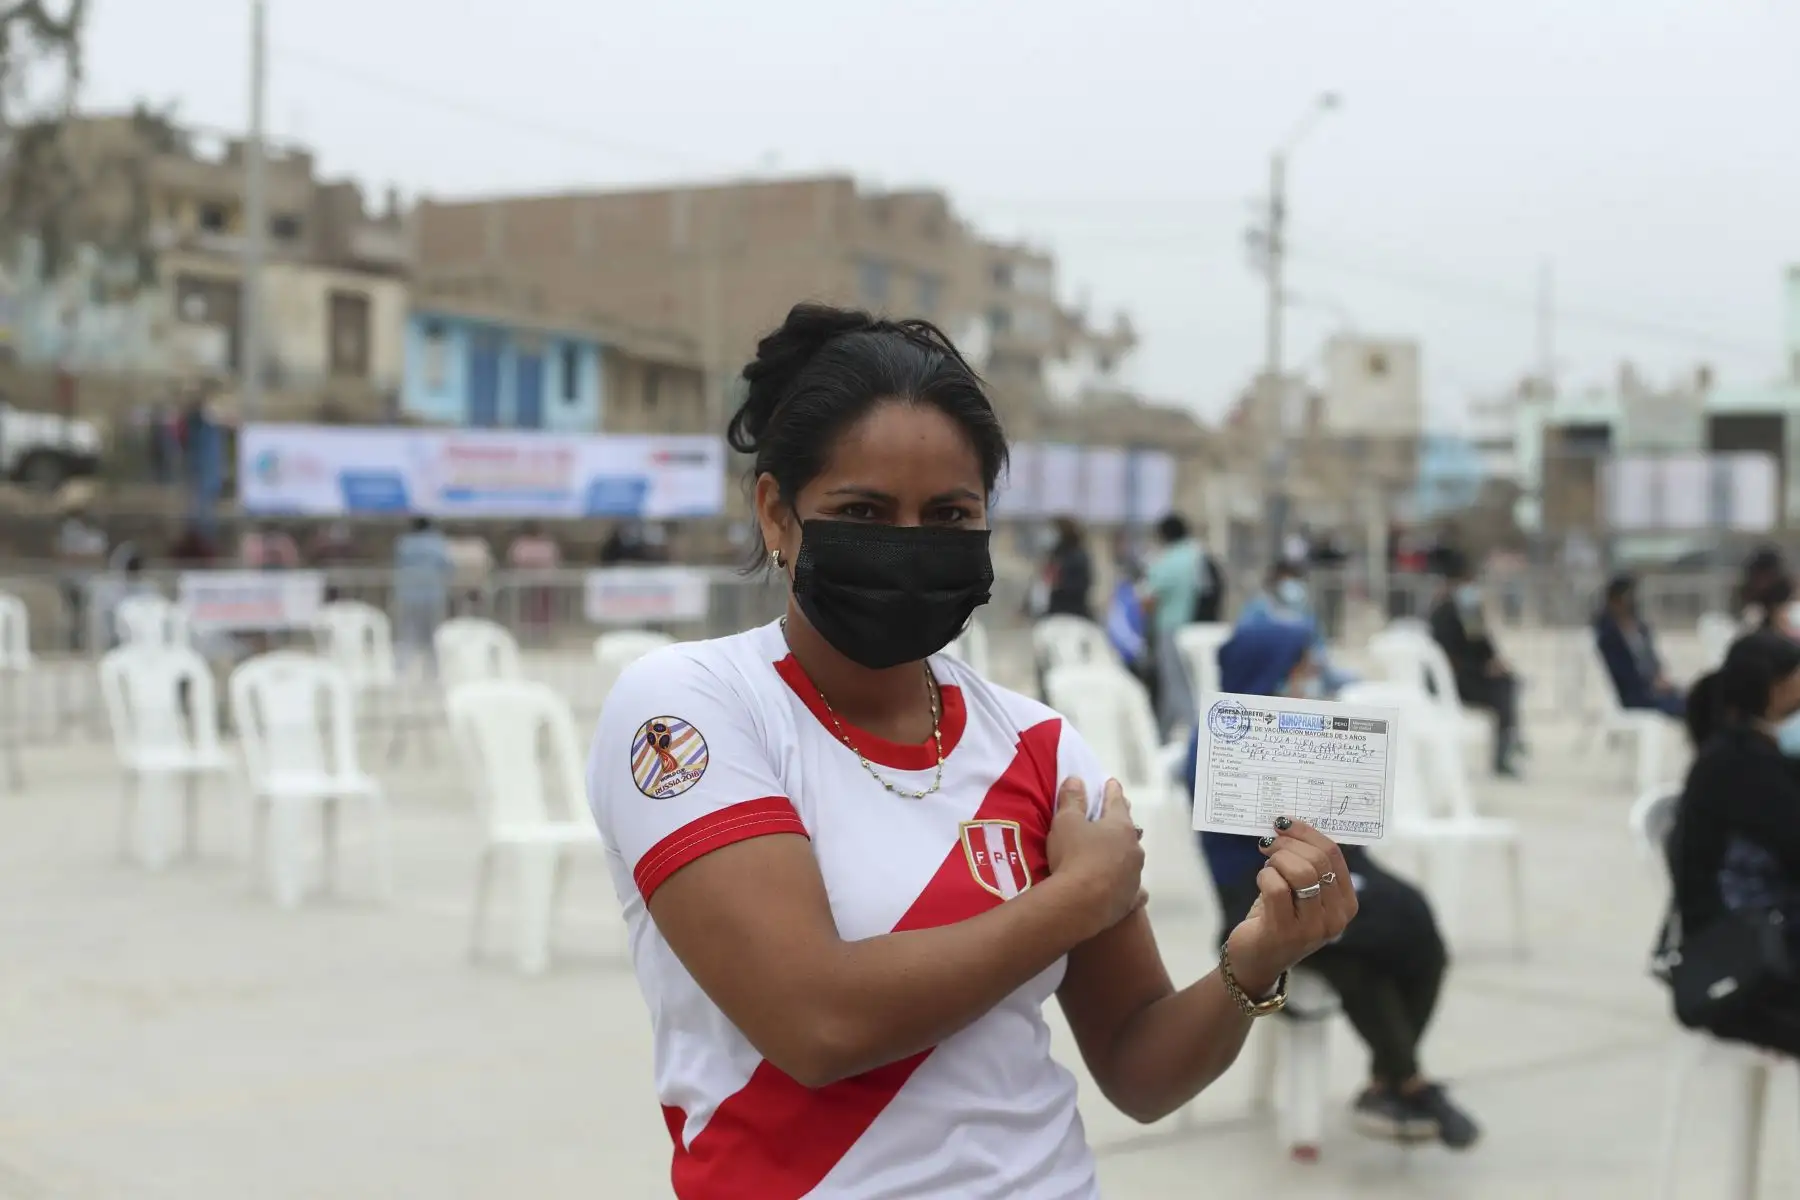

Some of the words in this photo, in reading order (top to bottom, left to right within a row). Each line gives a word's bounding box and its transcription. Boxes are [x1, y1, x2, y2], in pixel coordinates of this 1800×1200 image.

[1281, 713, 1324, 729] SINOPHARM
[1304, 730, 1333, 739] MAYORES
[655, 778, 681, 795] RUSSIA
[681, 770, 700, 782] 2018
